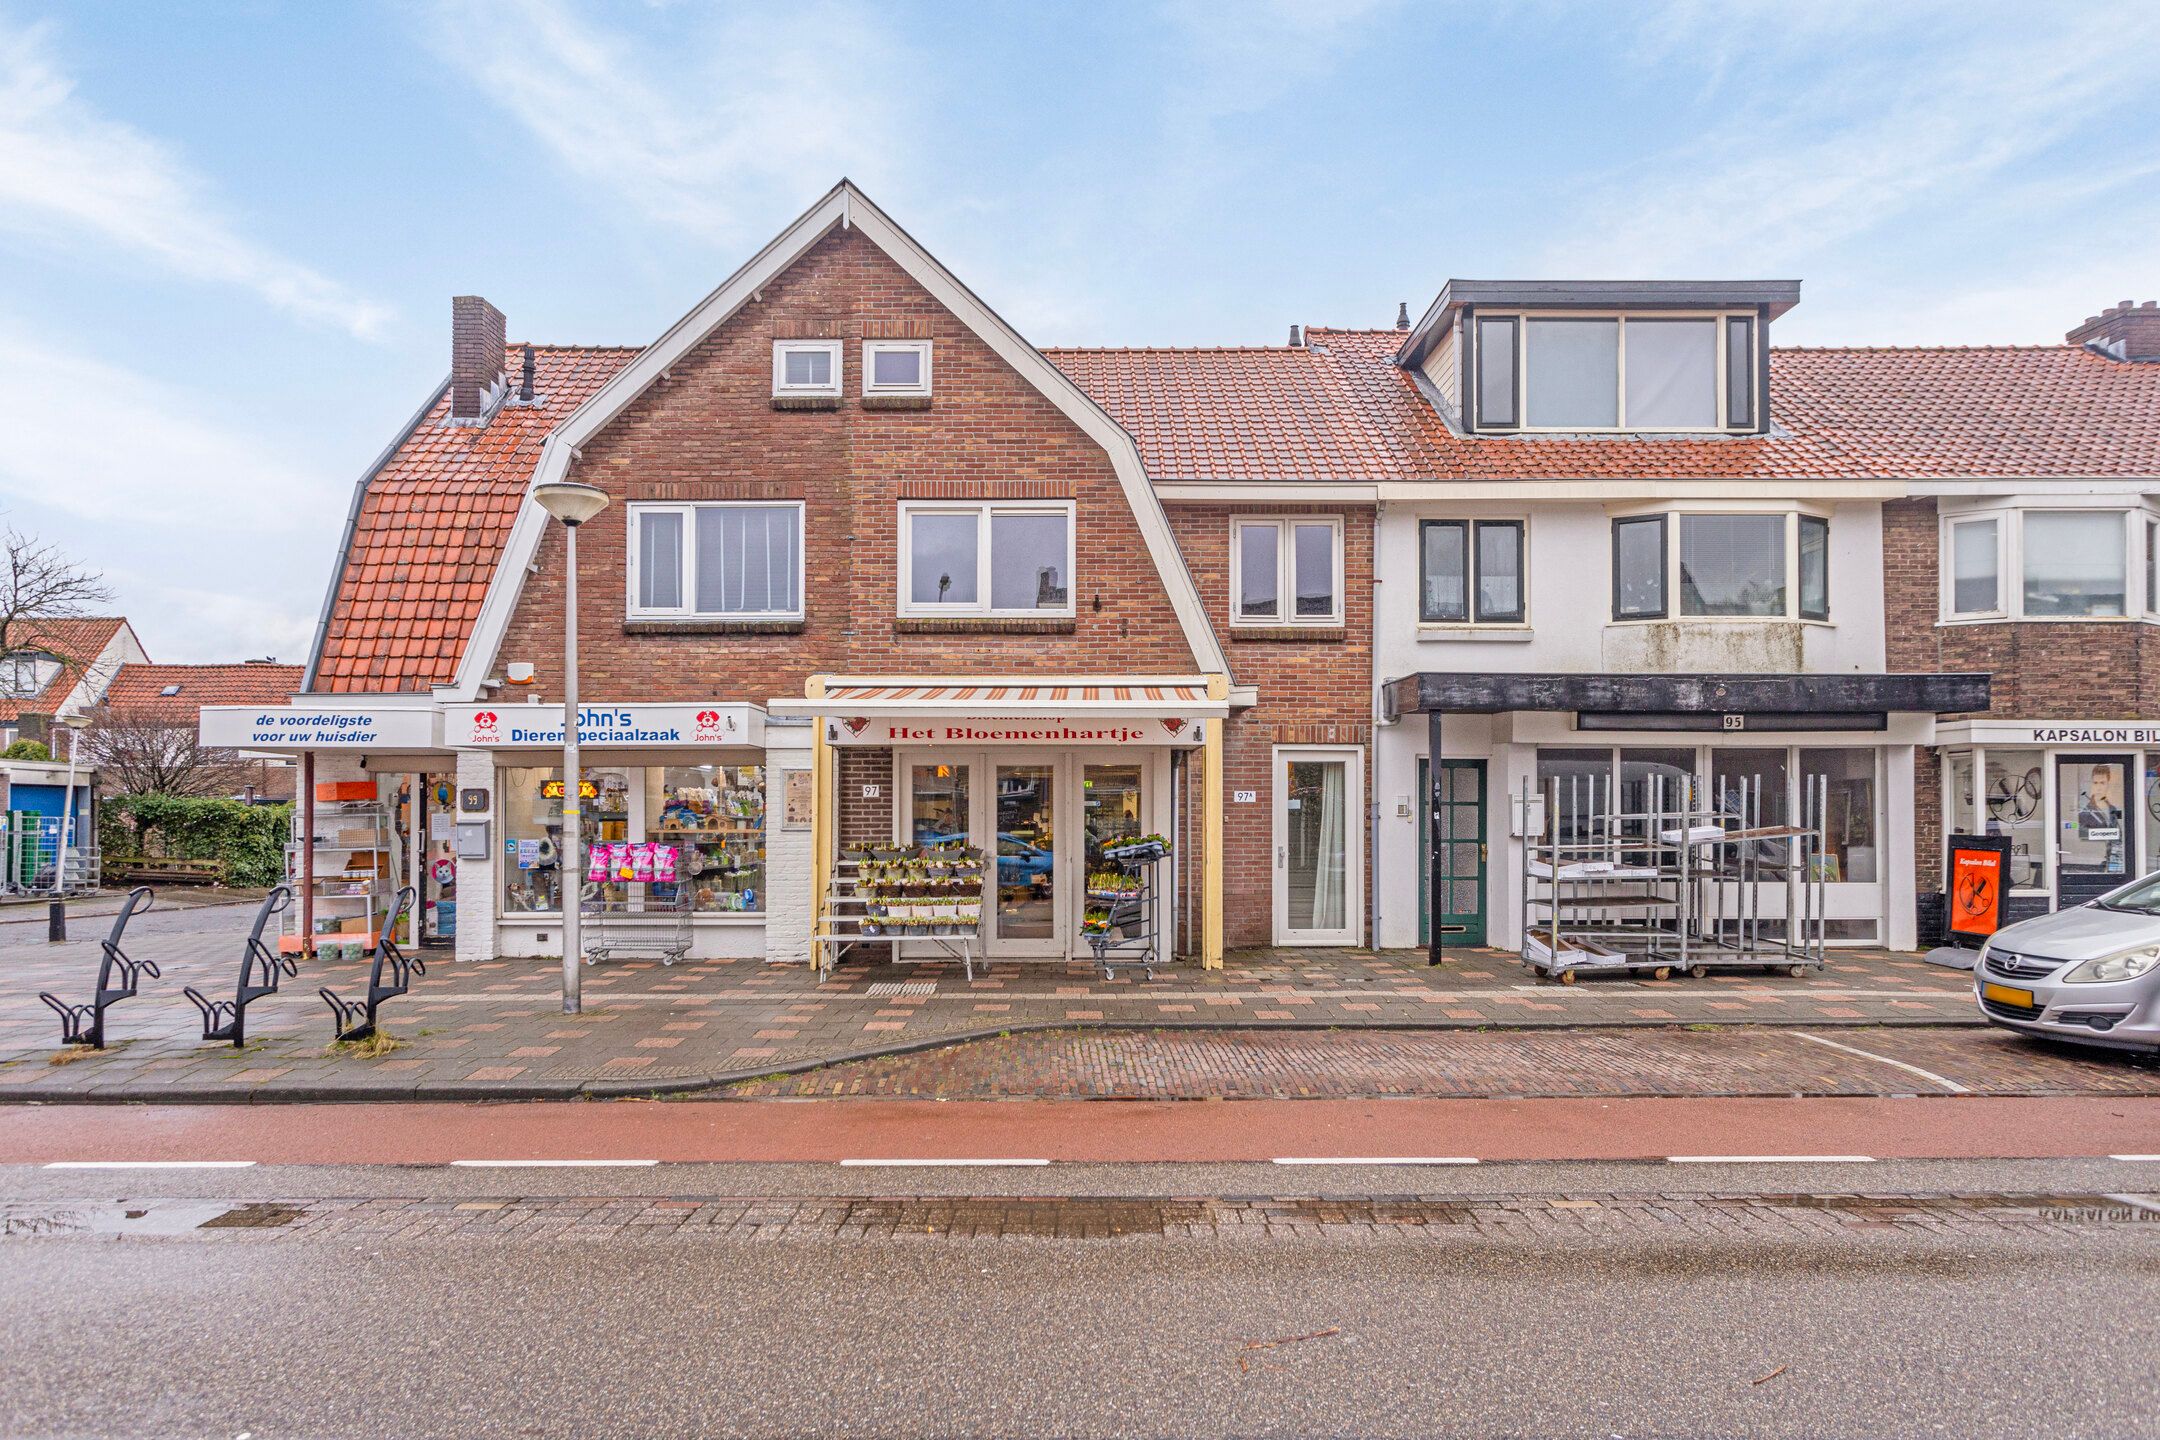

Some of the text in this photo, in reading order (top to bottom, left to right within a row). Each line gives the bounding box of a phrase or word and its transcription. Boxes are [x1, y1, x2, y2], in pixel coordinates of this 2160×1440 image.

[256, 715, 373, 728] de voordeligste
[561, 709, 632, 727] ohn's
[1725, 716, 1742, 728] 95
[252, 731, 378, 742] voor uw huisdier
[472, 734, 500, 743] John's
[511, 729, 680, 744] Dierenpeciaalzaak
[694, 733, 722, 742] John's
[888, 727, 1144, 742] Het Bloemenhartje
[2033, 730, 2127, 742] KAPSALON
[864, 786, 878, 796] 97
[467, 794, 478, 805] 99
